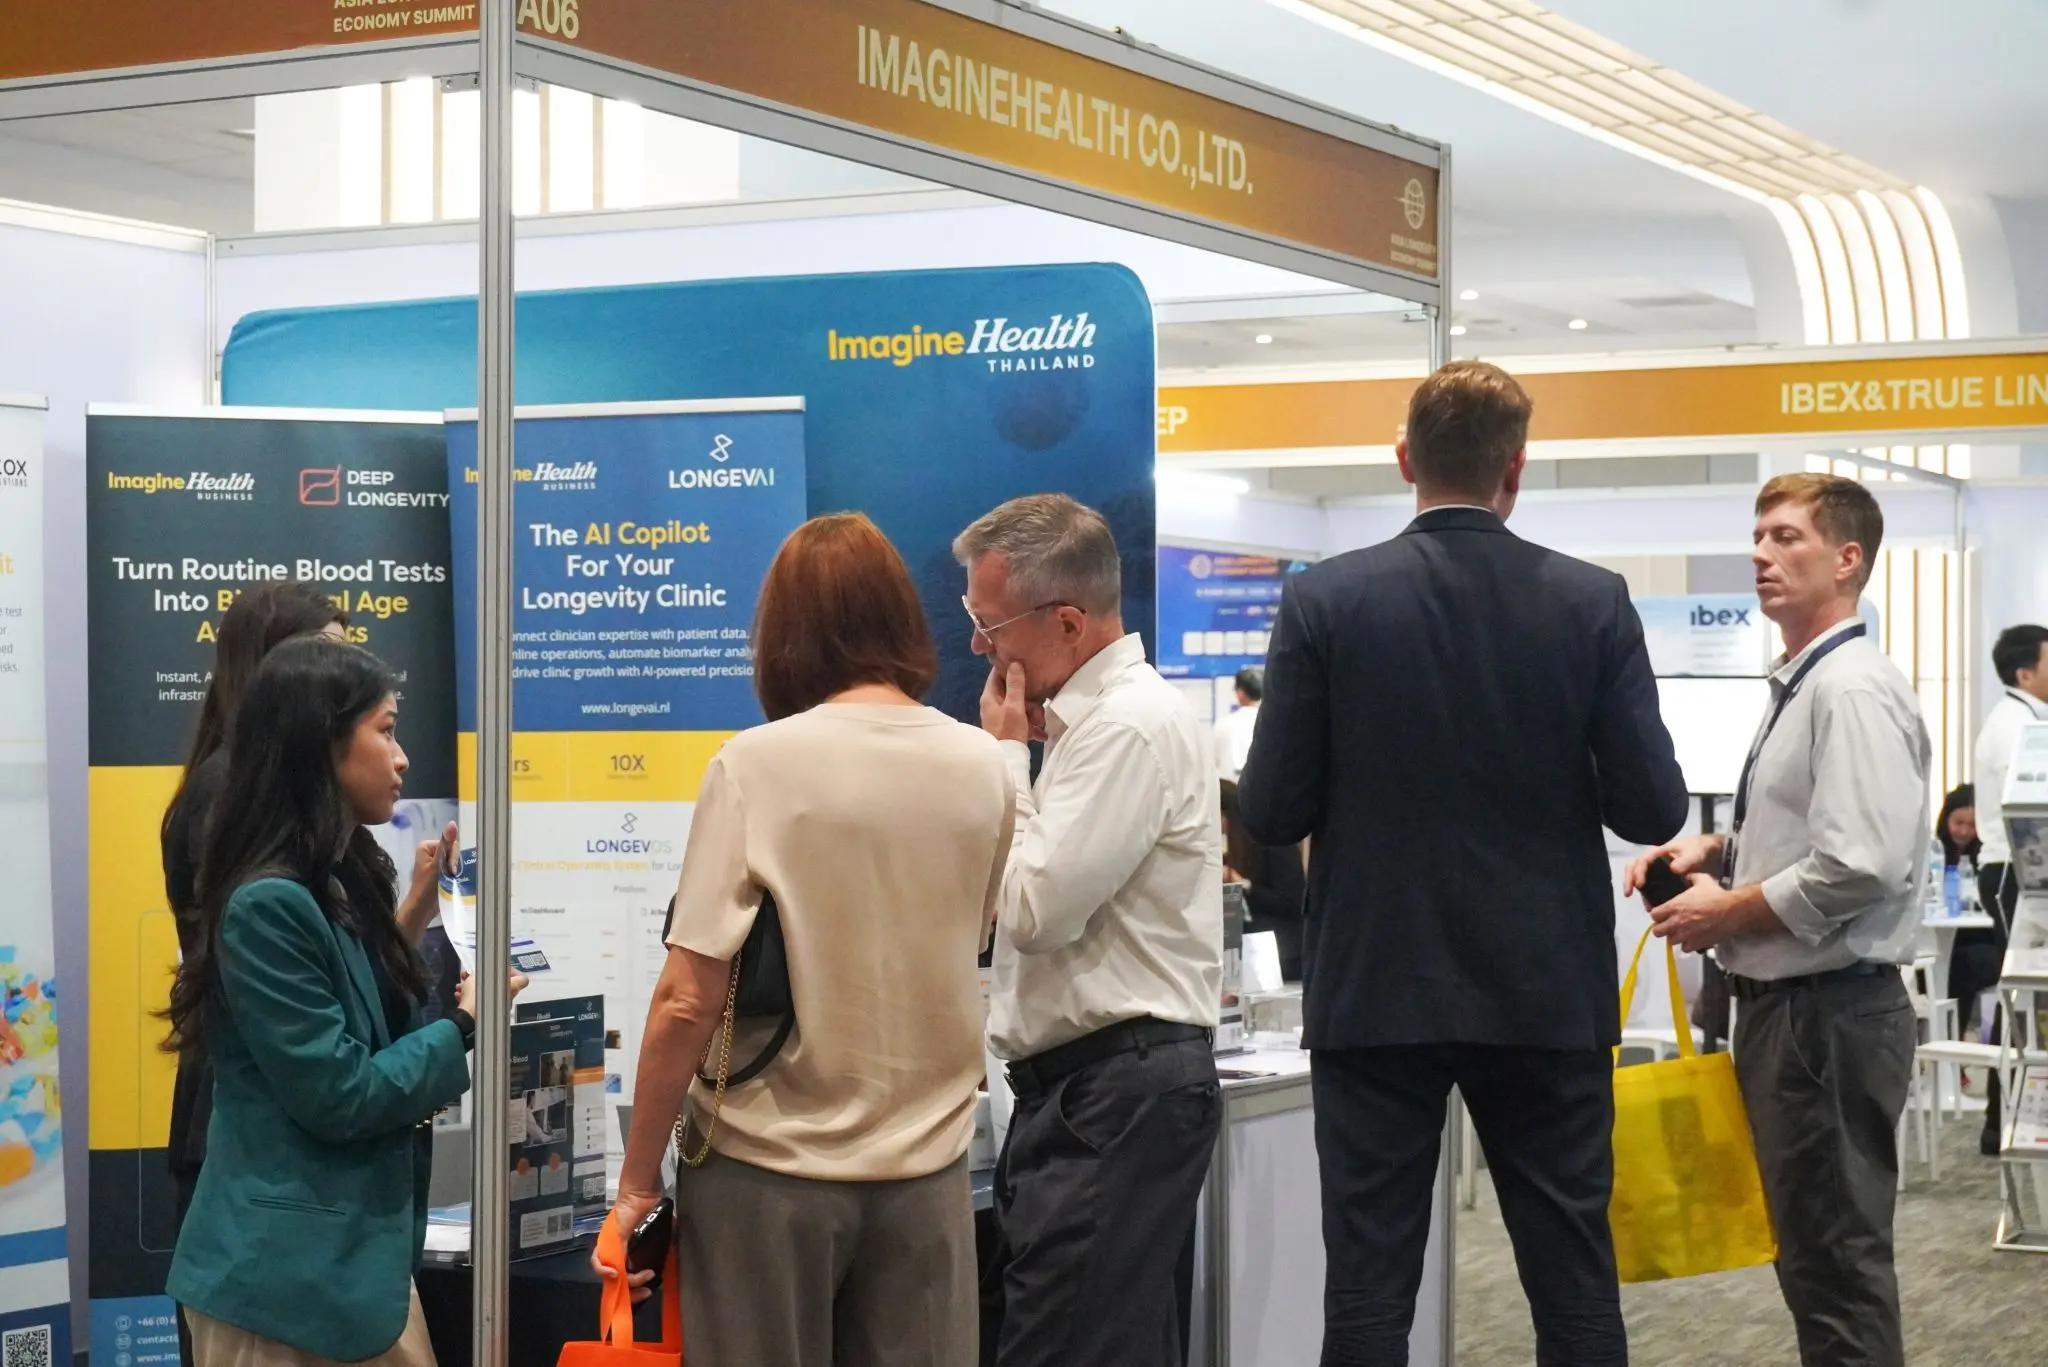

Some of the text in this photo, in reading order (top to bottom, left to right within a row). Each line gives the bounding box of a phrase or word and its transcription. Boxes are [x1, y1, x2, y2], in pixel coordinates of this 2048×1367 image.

[334, 4, 476, 32] ECONOMY SUMMIT
[517, 0, 579, 39] A06
[857, 25, 1253, 194] IMAGINEHEALTH CO.,LTD.
[987, 354, 1095, 373] THAILAND
[1781, 373, 2048, 414] IBEX&TRUE LIN
[0, 459, 27, 477] OX
[347, 470, 394, 486] DEEP
[543, 482, 596, 491] BUSINESS
[669, 468, 774, 489] LONGEVAI
[197, 491, 253, 501] BUSINESS
[347, 491, 450, 508] LONGEVITY
[529, 520, 711, 550] The AI Copilot
[112, 557, 446, 583] Turn Routine Blood Tests
[567, 553, 674, 577] For Your
[154, 589, 209, 612] Into
[356, 591, 409, 619] Age
[523, 583, 726, 615] Longevity Clinic
[1690, 604, 1750, 626] ibex
[549, 629, 596, 641] clinician
[598, 629, 649, 643] expertise
[651, 628, 675, 641] with
[677, 628, 718, 643] patient
[541, 648, 606, 662] operations,
[608, 648, 661, 660] automate
[663, 647, 721, 659] biomarker
[512, 667, 540, 678] drive
[542, 666, 571, 678] clinic
[574, 666, 615, 680] growth
[617, 665, 640, 677] with
[643, 665, 706, 679] AI-powered
[581, 702, 670, 716] www.longevai.nl
[610, 754, 645, 772] 10X
